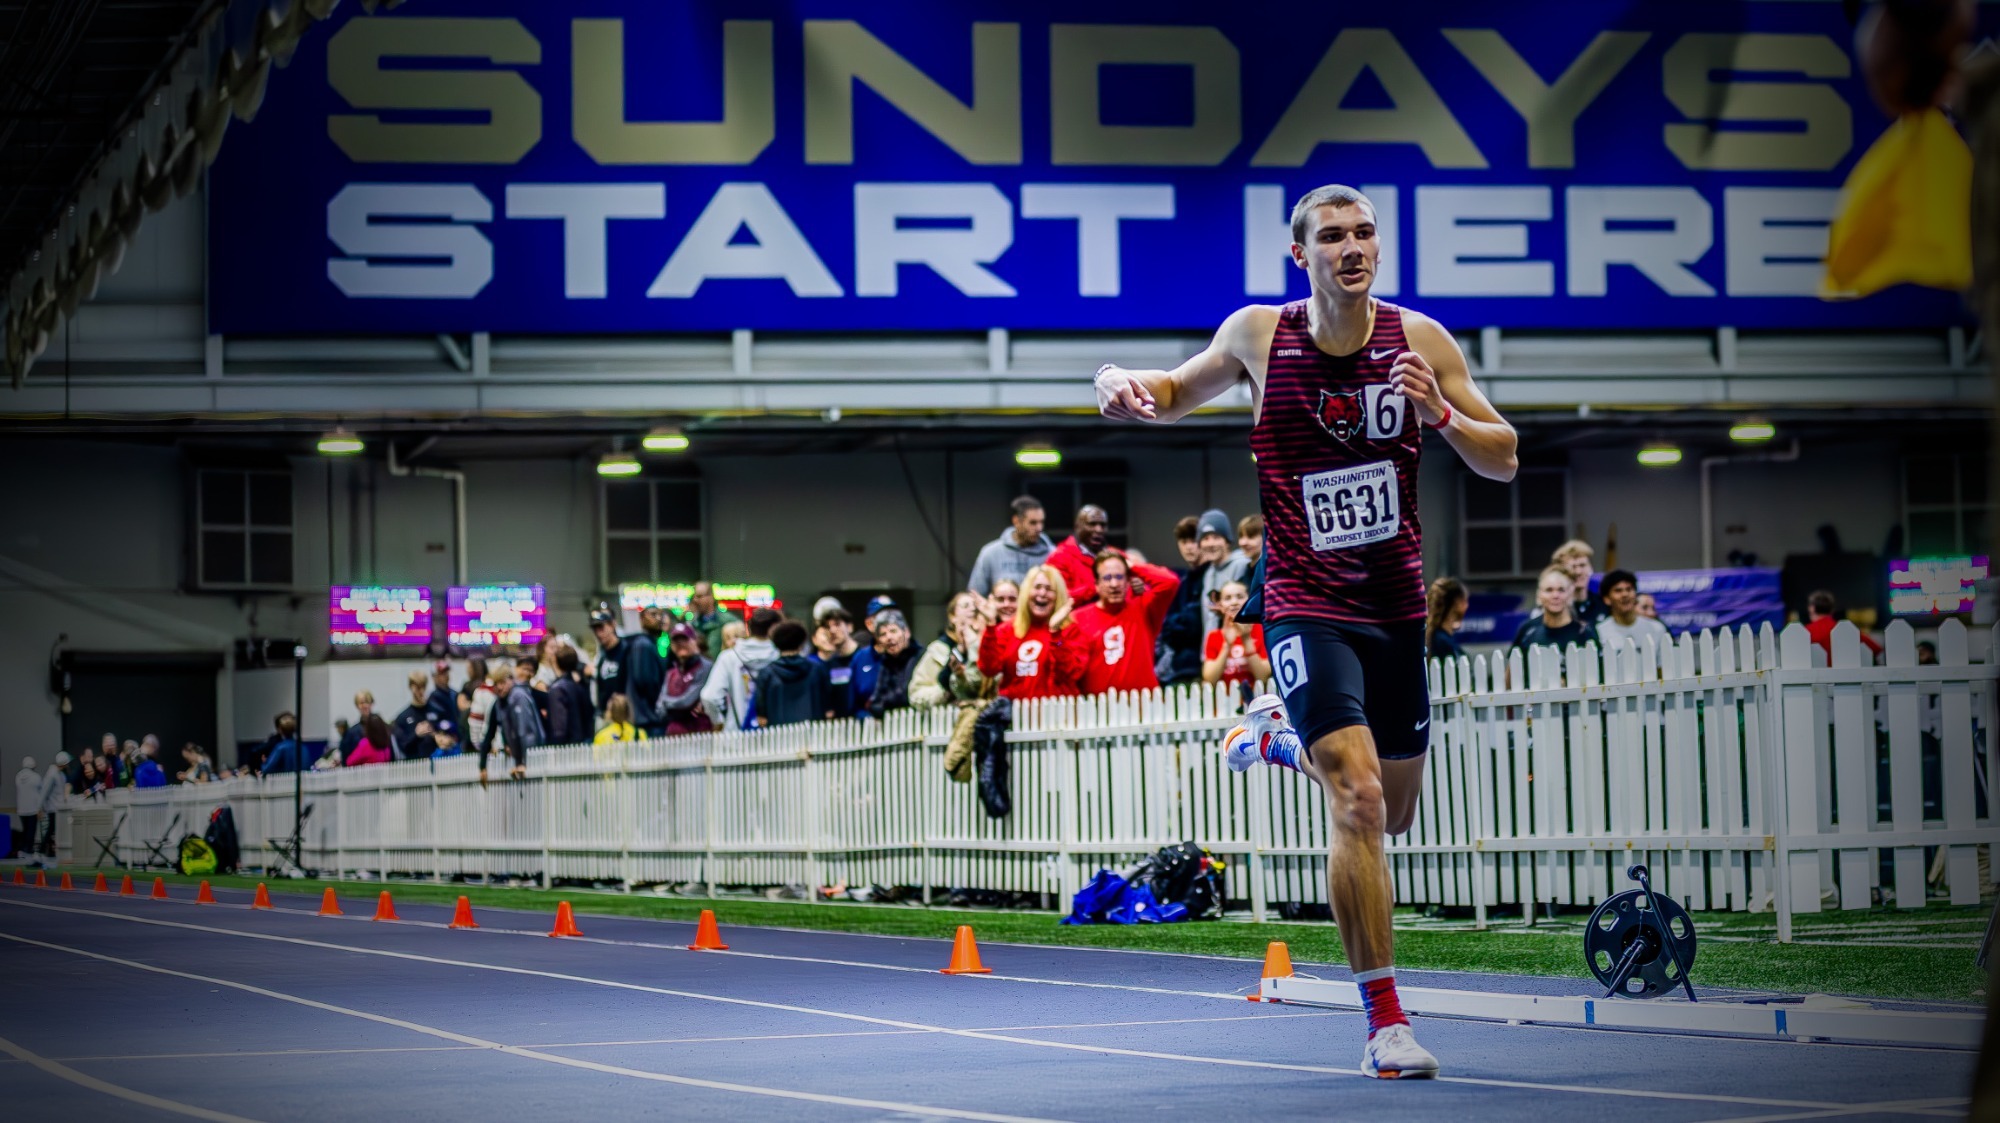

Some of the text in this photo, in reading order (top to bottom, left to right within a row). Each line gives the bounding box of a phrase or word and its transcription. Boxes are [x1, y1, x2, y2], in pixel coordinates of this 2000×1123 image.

[327, 17, 1853, 171] SUNDAYS
[327, 183, 1838, 299] START HERE
[1376, 387, 1397, 436] 6
[1312, 467, 1387, 489] WASHINGTON
[1311, 480, 1395, 534] 6631
[1325, 526, 1390, 544] DEMPSEY INDOOR
[1278, 642, 1298, 689] 6
